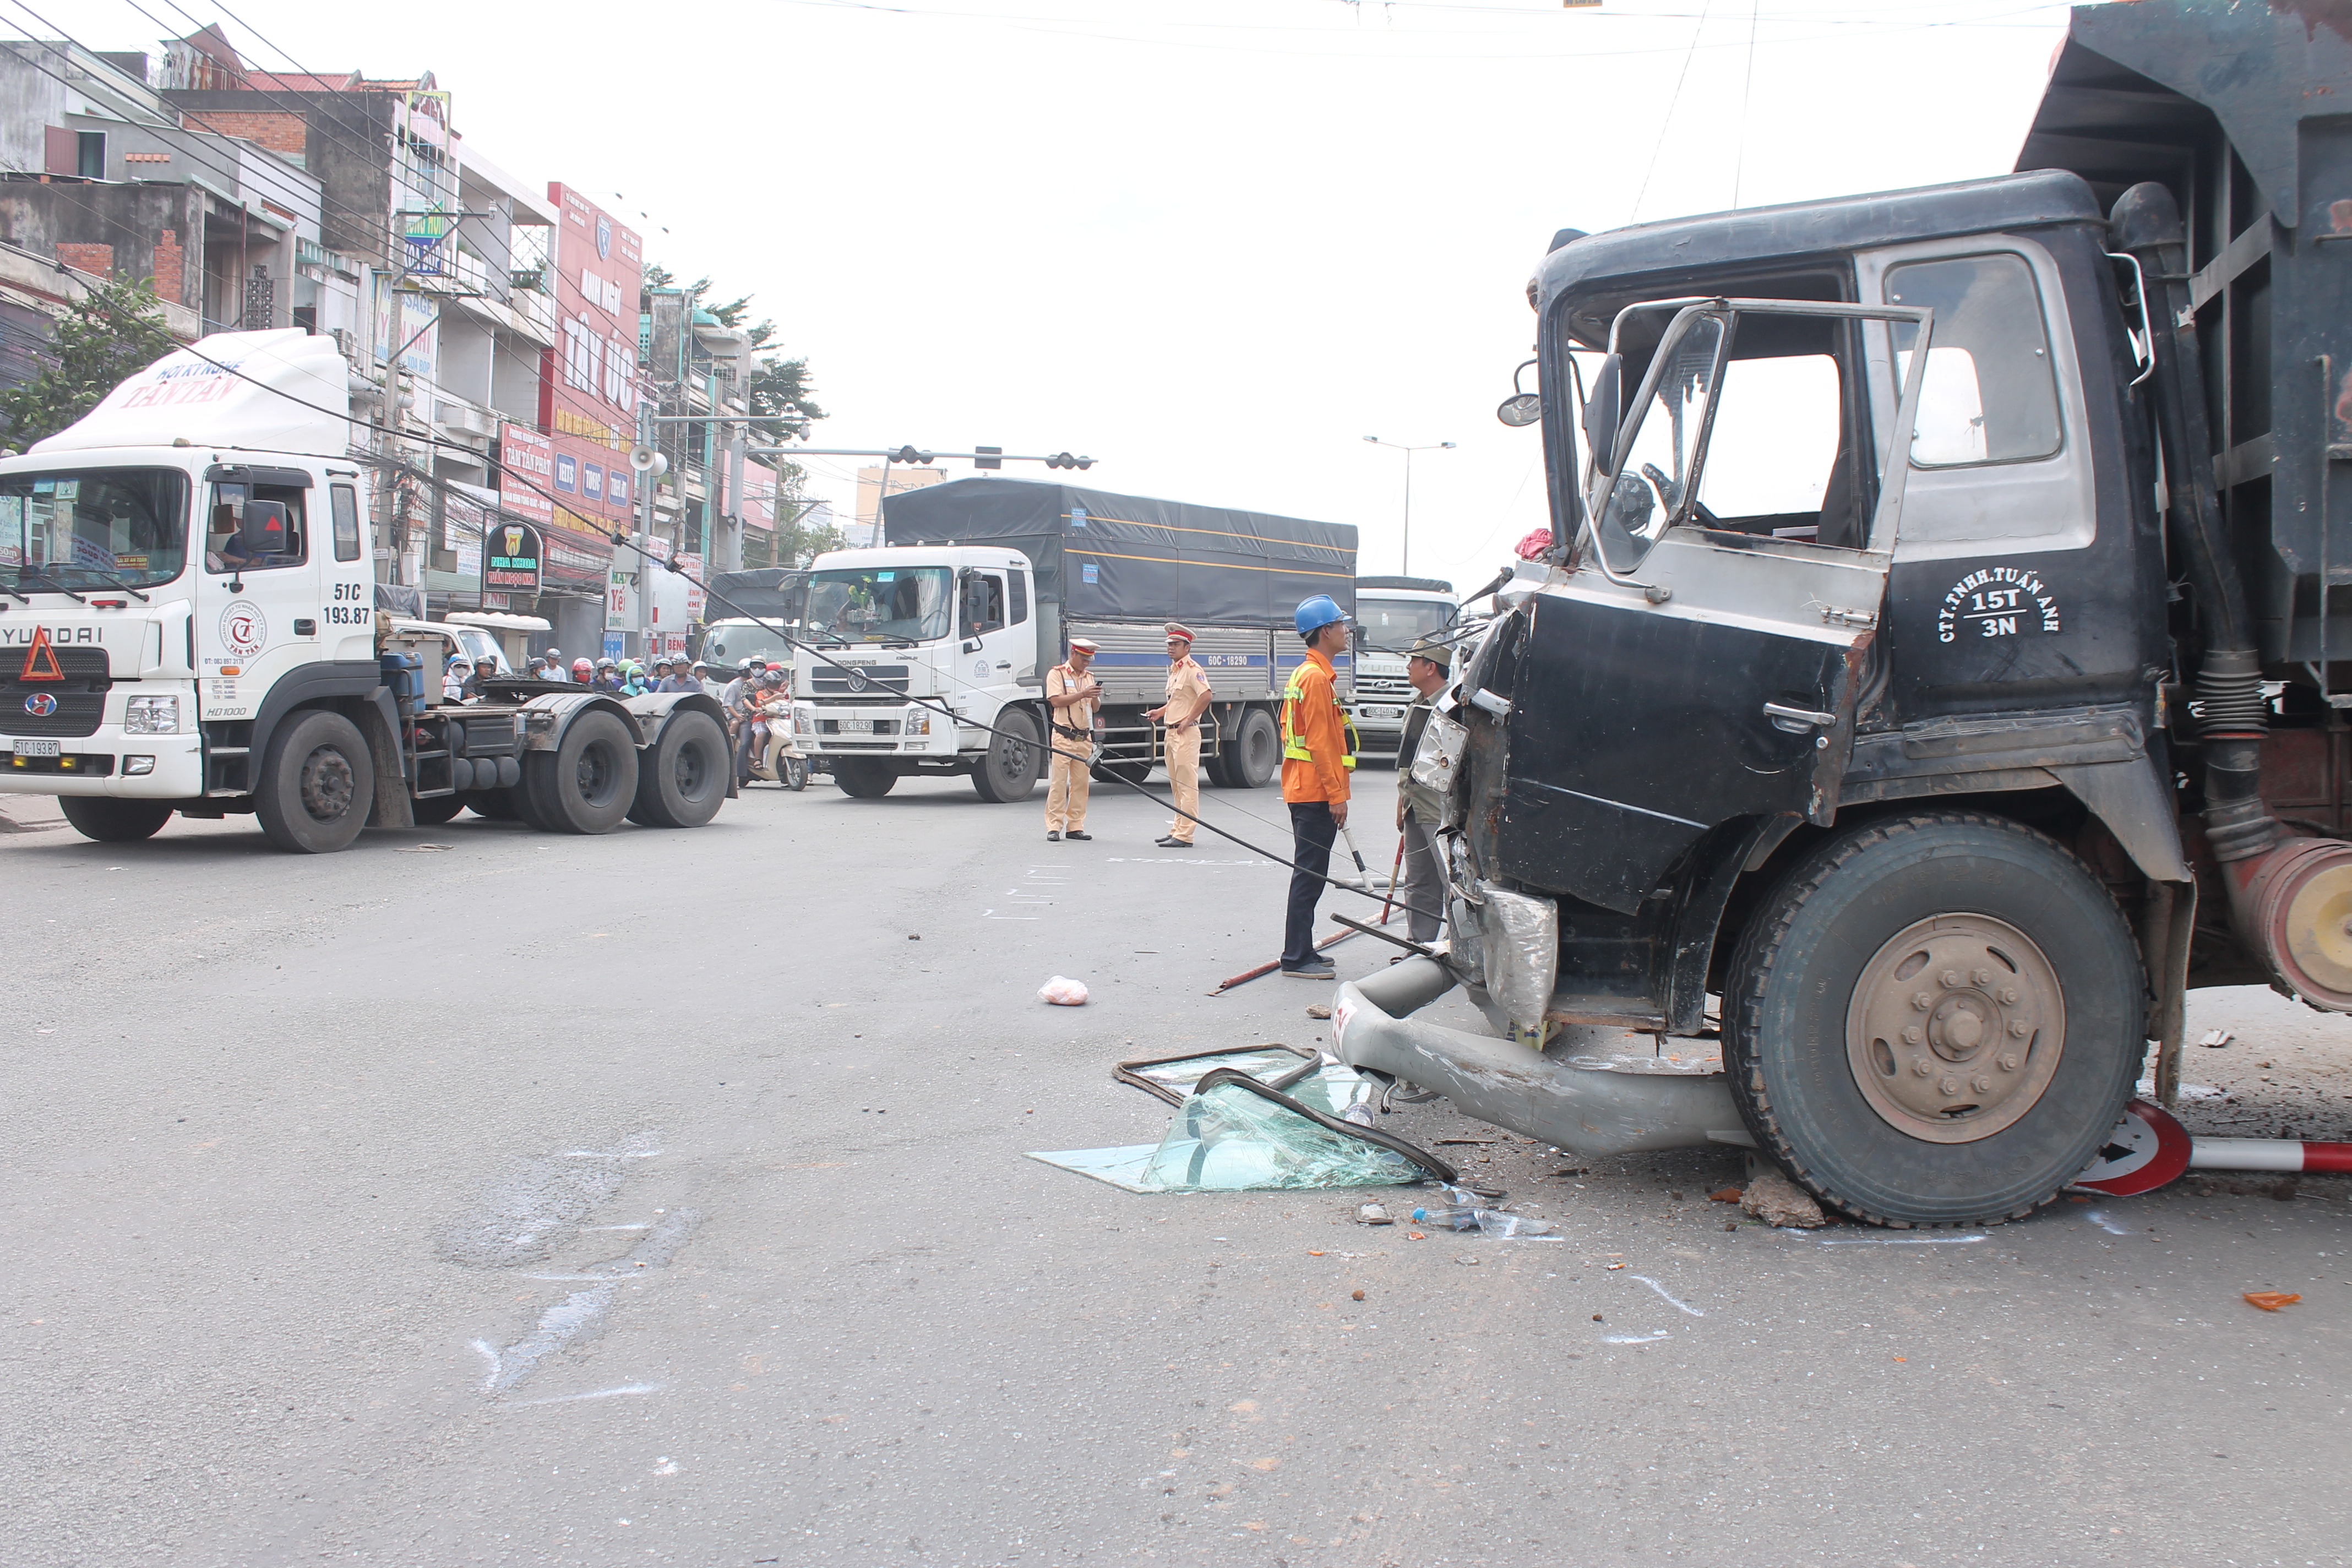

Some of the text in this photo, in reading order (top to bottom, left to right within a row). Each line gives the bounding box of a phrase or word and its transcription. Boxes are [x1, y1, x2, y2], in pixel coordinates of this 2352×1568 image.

[383, 280, 434, 318] MSSAGE
[581, 268, 622, 318] ANH NGỮ
[563, 311, 634, 412] TÂY ÚC
[535, 452, 551, 476] PHÁT
[558, 461, 574, 484] IELTS
[585, 469, 601, 492] TOEIC
[491, 556, 511, 569] NHA
[512, 557, 537, 569] KHOA
[488, 568, 536, 589] TUẤN NGỌC NHA
[334, 583, 361, 601] 51C
[688, 587, 700, 597] ỆNH
[1971, 588, 2021, 611] 15T
[323, 606, 370, 624] 193.87
[2036, 596, 2060, 632] ANH
[1980, 616, 2017, 638] 3N
[206, 707, 247, 717] HD1000
